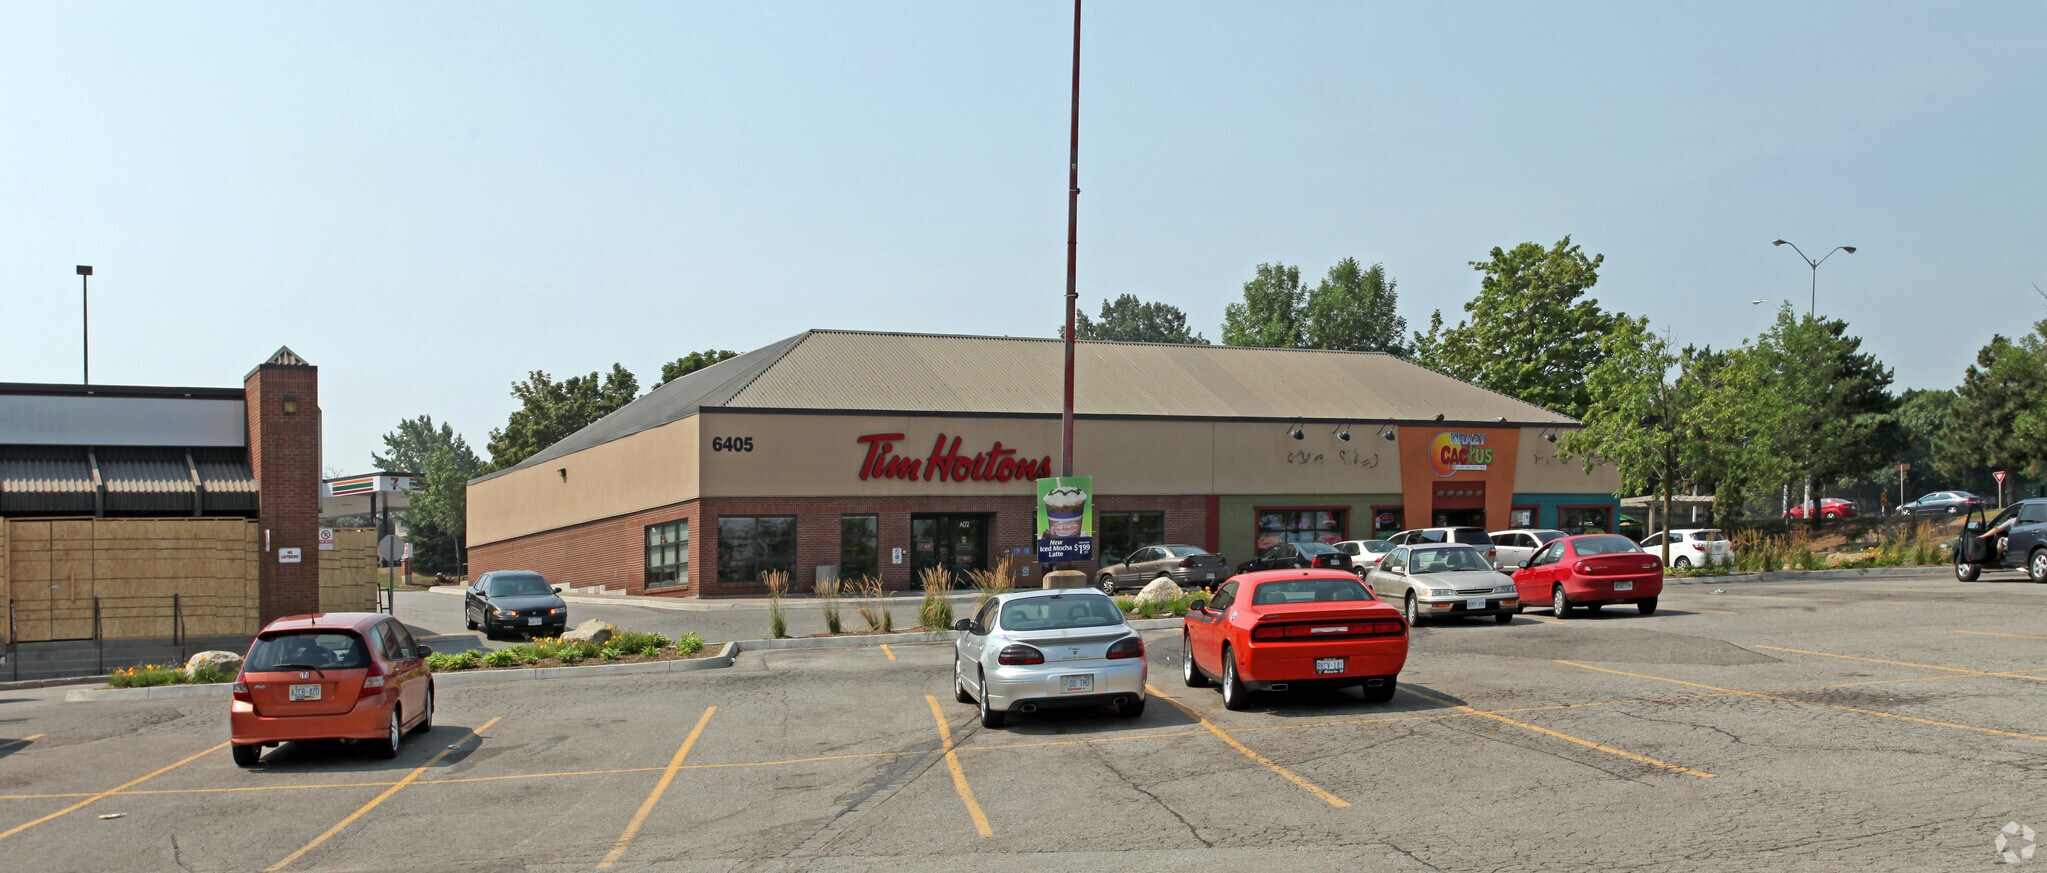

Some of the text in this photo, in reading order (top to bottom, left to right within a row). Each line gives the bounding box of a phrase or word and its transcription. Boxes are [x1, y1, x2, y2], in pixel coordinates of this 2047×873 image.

[712, 436, 754, 452] 6405
[1449, 431, 1486, 445] KRAZY
[856, 432, 1052, 482] Tim Hortons
[1440, 445, 1493, 465] CACTUS
